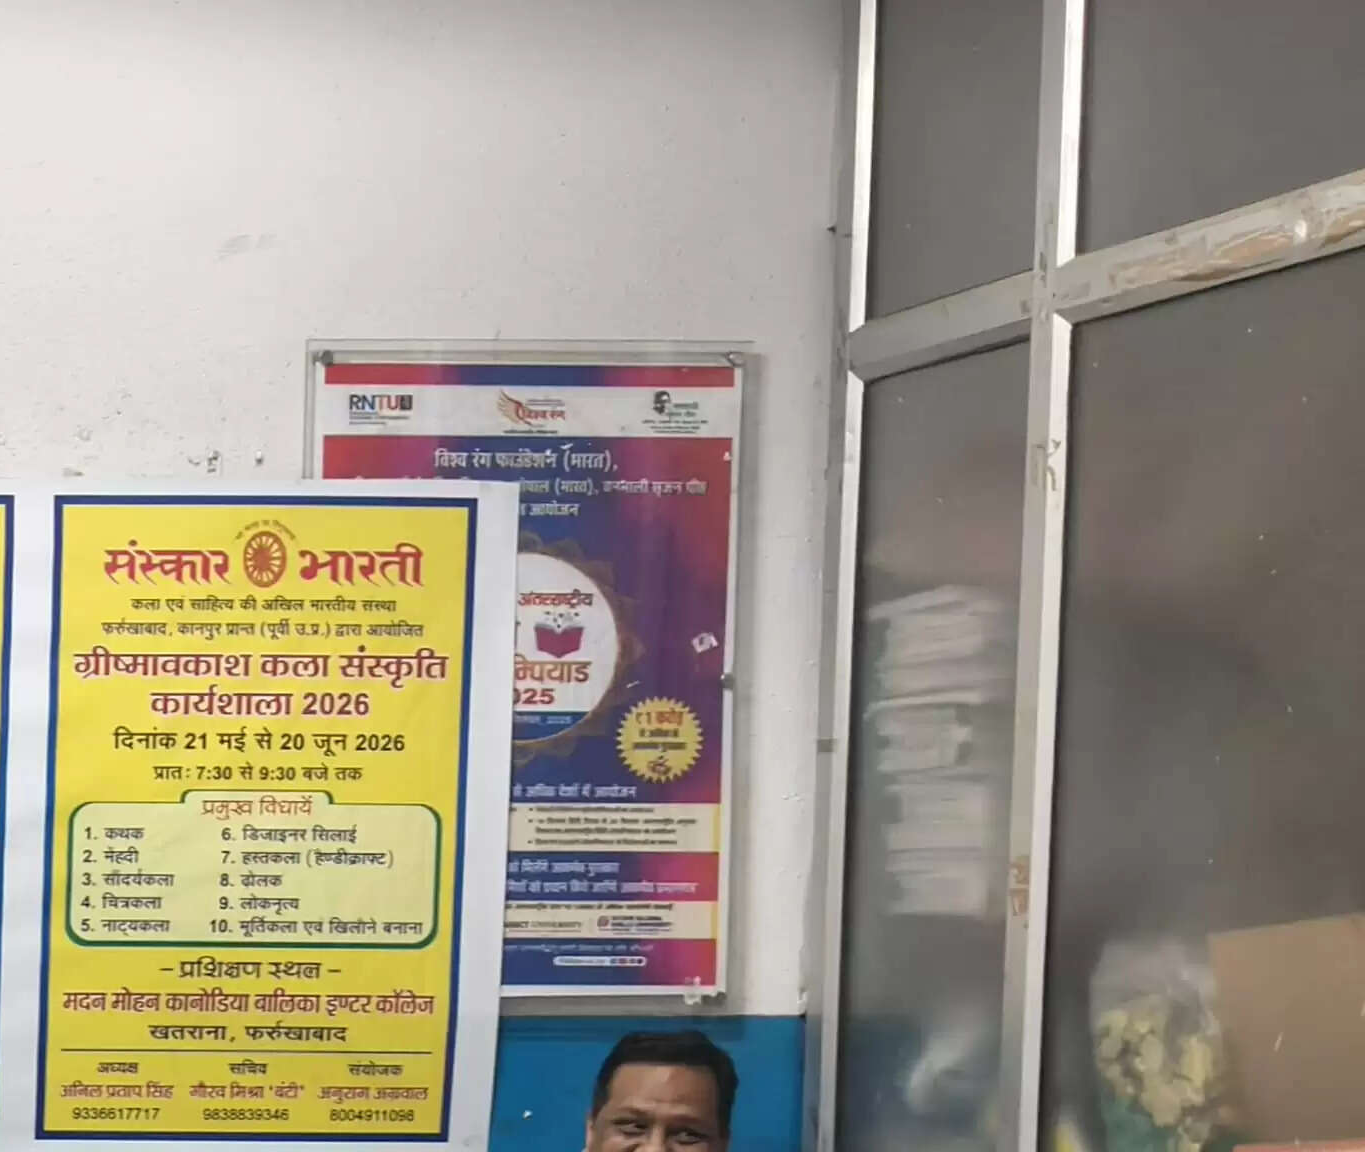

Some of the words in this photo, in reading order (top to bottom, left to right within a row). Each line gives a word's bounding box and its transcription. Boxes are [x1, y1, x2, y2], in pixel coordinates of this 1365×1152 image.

[348, 394, 401, 411] RNTU
[472, 448, 491, 468] रंग
[104, 539, 230, 583] संस्कार
[298, 542, 424, 586] भारती
[73, 645, 253, 682] ग्रीष्मावकाश
[260, 654, 331, 678] कला
[338, 644, 450, 689] संस्कृति
[150, 685, 294, 716] कार्यशाला
[301, 692, 370, 716] 2026
[513, 687, 556, 705] 25
[112, 725, 178, 750] दिनांक
[184, 732, 207, 750] 21
[216, 725, 247, 753] मई
[253, 727, 273, 750] से
[279, 732, 305, 751] 20
[311, 733, 348, 757] जून
[354, 733, 405, 752] 2026
